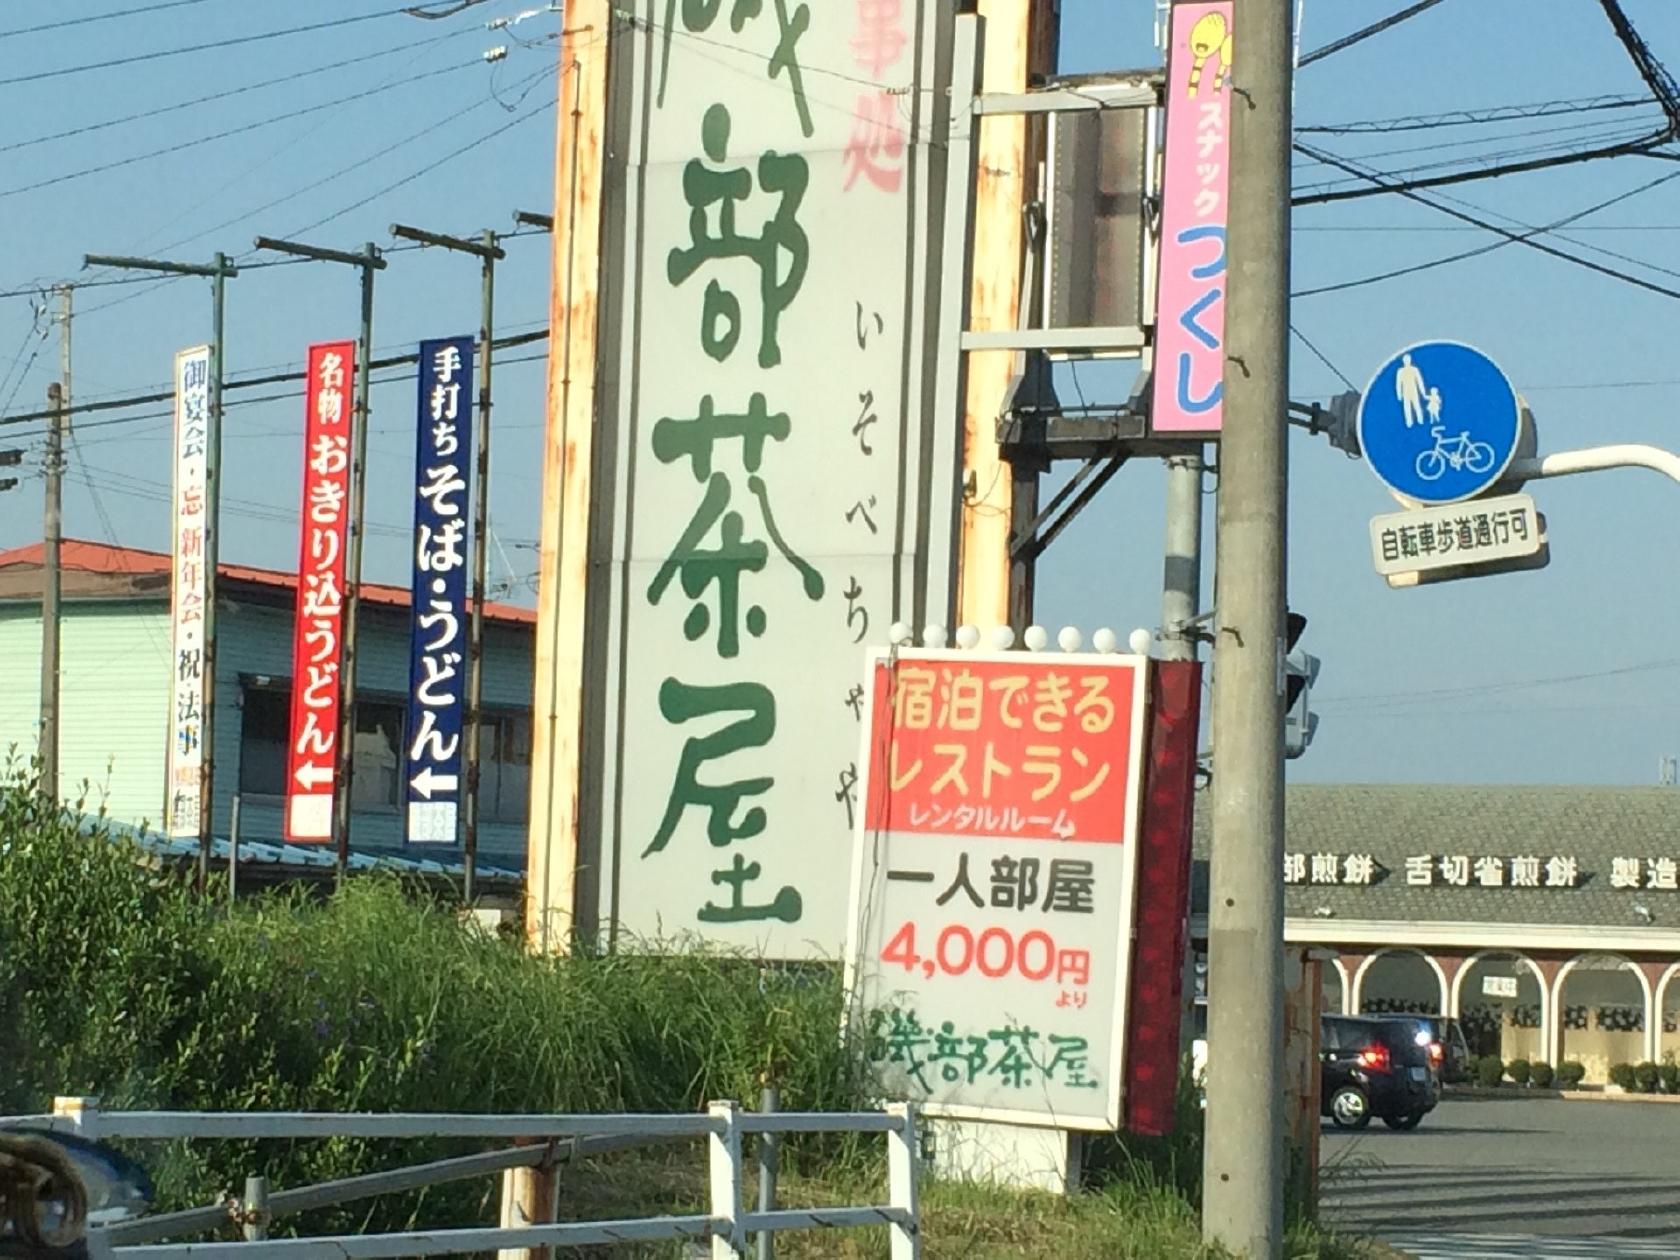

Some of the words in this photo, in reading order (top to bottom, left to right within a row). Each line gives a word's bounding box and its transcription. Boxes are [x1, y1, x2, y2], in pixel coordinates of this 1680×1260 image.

[1193, 102, 1224, 217] スナック
[1176, 224, 1228, 414] つくし
[317, 351, 345, 425] 名物
[430, 346, 462, 456] 手打ち
[1381, 508, 1529, 562] 自転車歩道通行可
[295, 434, 348, 756] おきり込うどん
[410, 466, 467, 762] そば・うどん
[892, 667, 1116, 734] 宿泊できる
[889, 741, 1111, 803] レストラン
[909, 803, 1076, 839] レンタルルーム
[886, 852, 1097, 914] 一人部屋
[1405, 854, 1577, 888] 舌切雀煎餅
[1610, 856, 1678, 889] 製造
[879, 920, 1091, 986] 4,000円
[1055, 990, 1088, 1009] より
